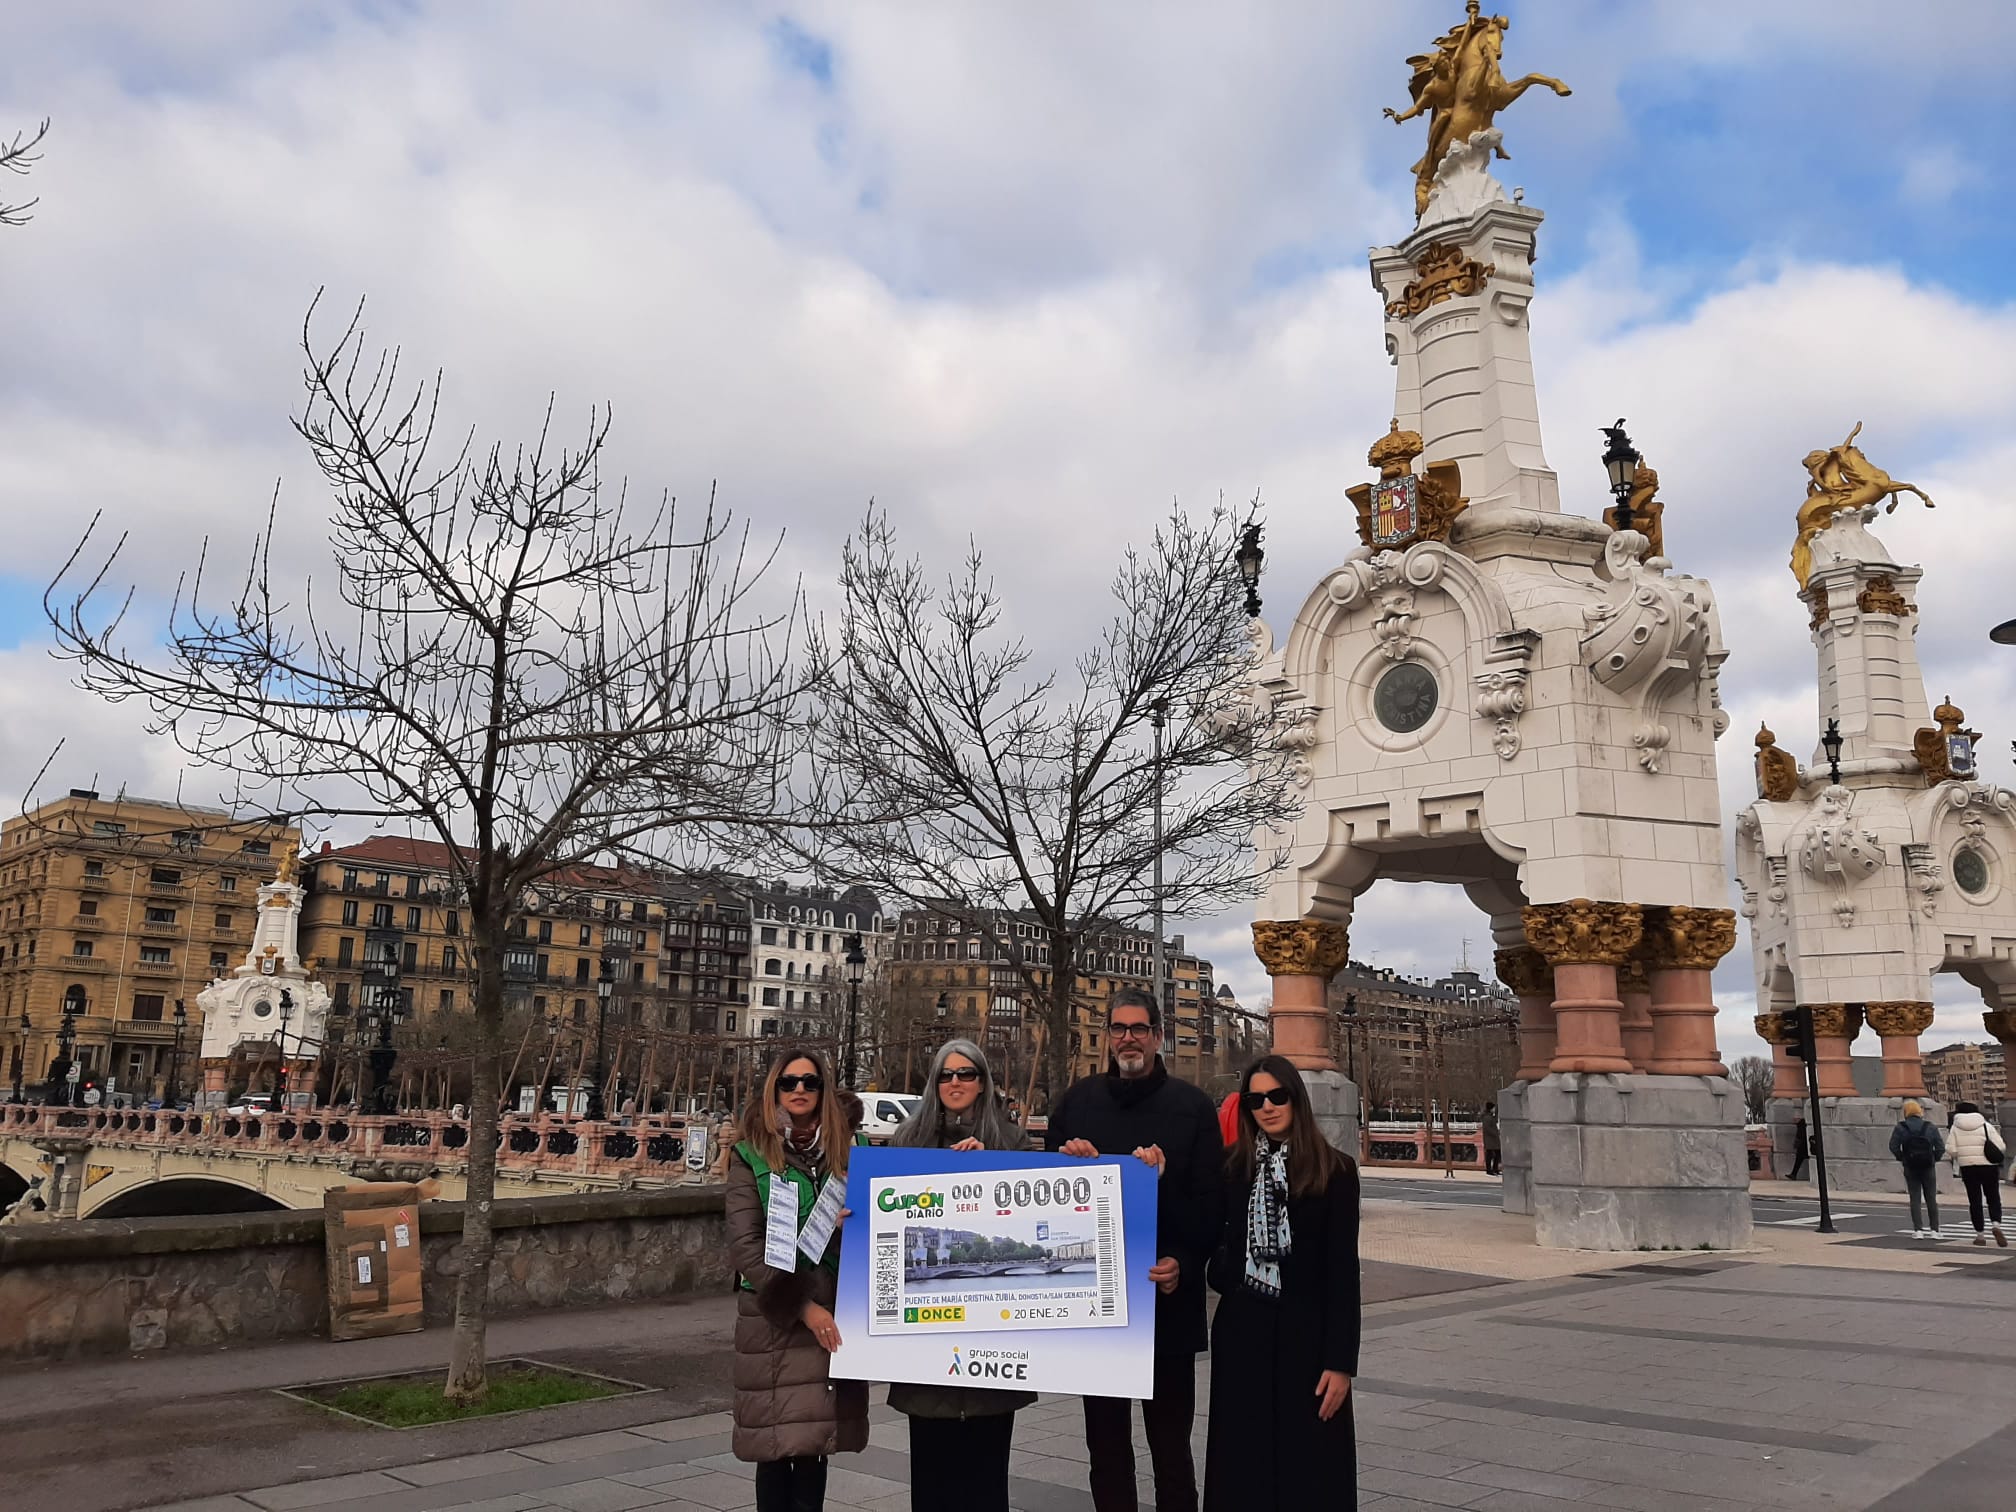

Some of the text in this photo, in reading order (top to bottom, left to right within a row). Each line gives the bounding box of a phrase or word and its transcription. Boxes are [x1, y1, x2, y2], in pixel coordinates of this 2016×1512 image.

[1103, 1175, 1114, 1185] 2€
[951, 1176, 1091, 1208] 000 00000
[904, 1296, 930, 1305] PUENTE
[931, 1296, 940, 1304] DE
[963, 1292, 994, 1303] CRISTINA
[921, 1307, 962, 1320] ONCE
[1014, 1307, 1069, 1320] 20 ENE. 25
[969, 1349, 1029, 1360] grupo social
[968, 1361, 1028, 1380] ONCE
